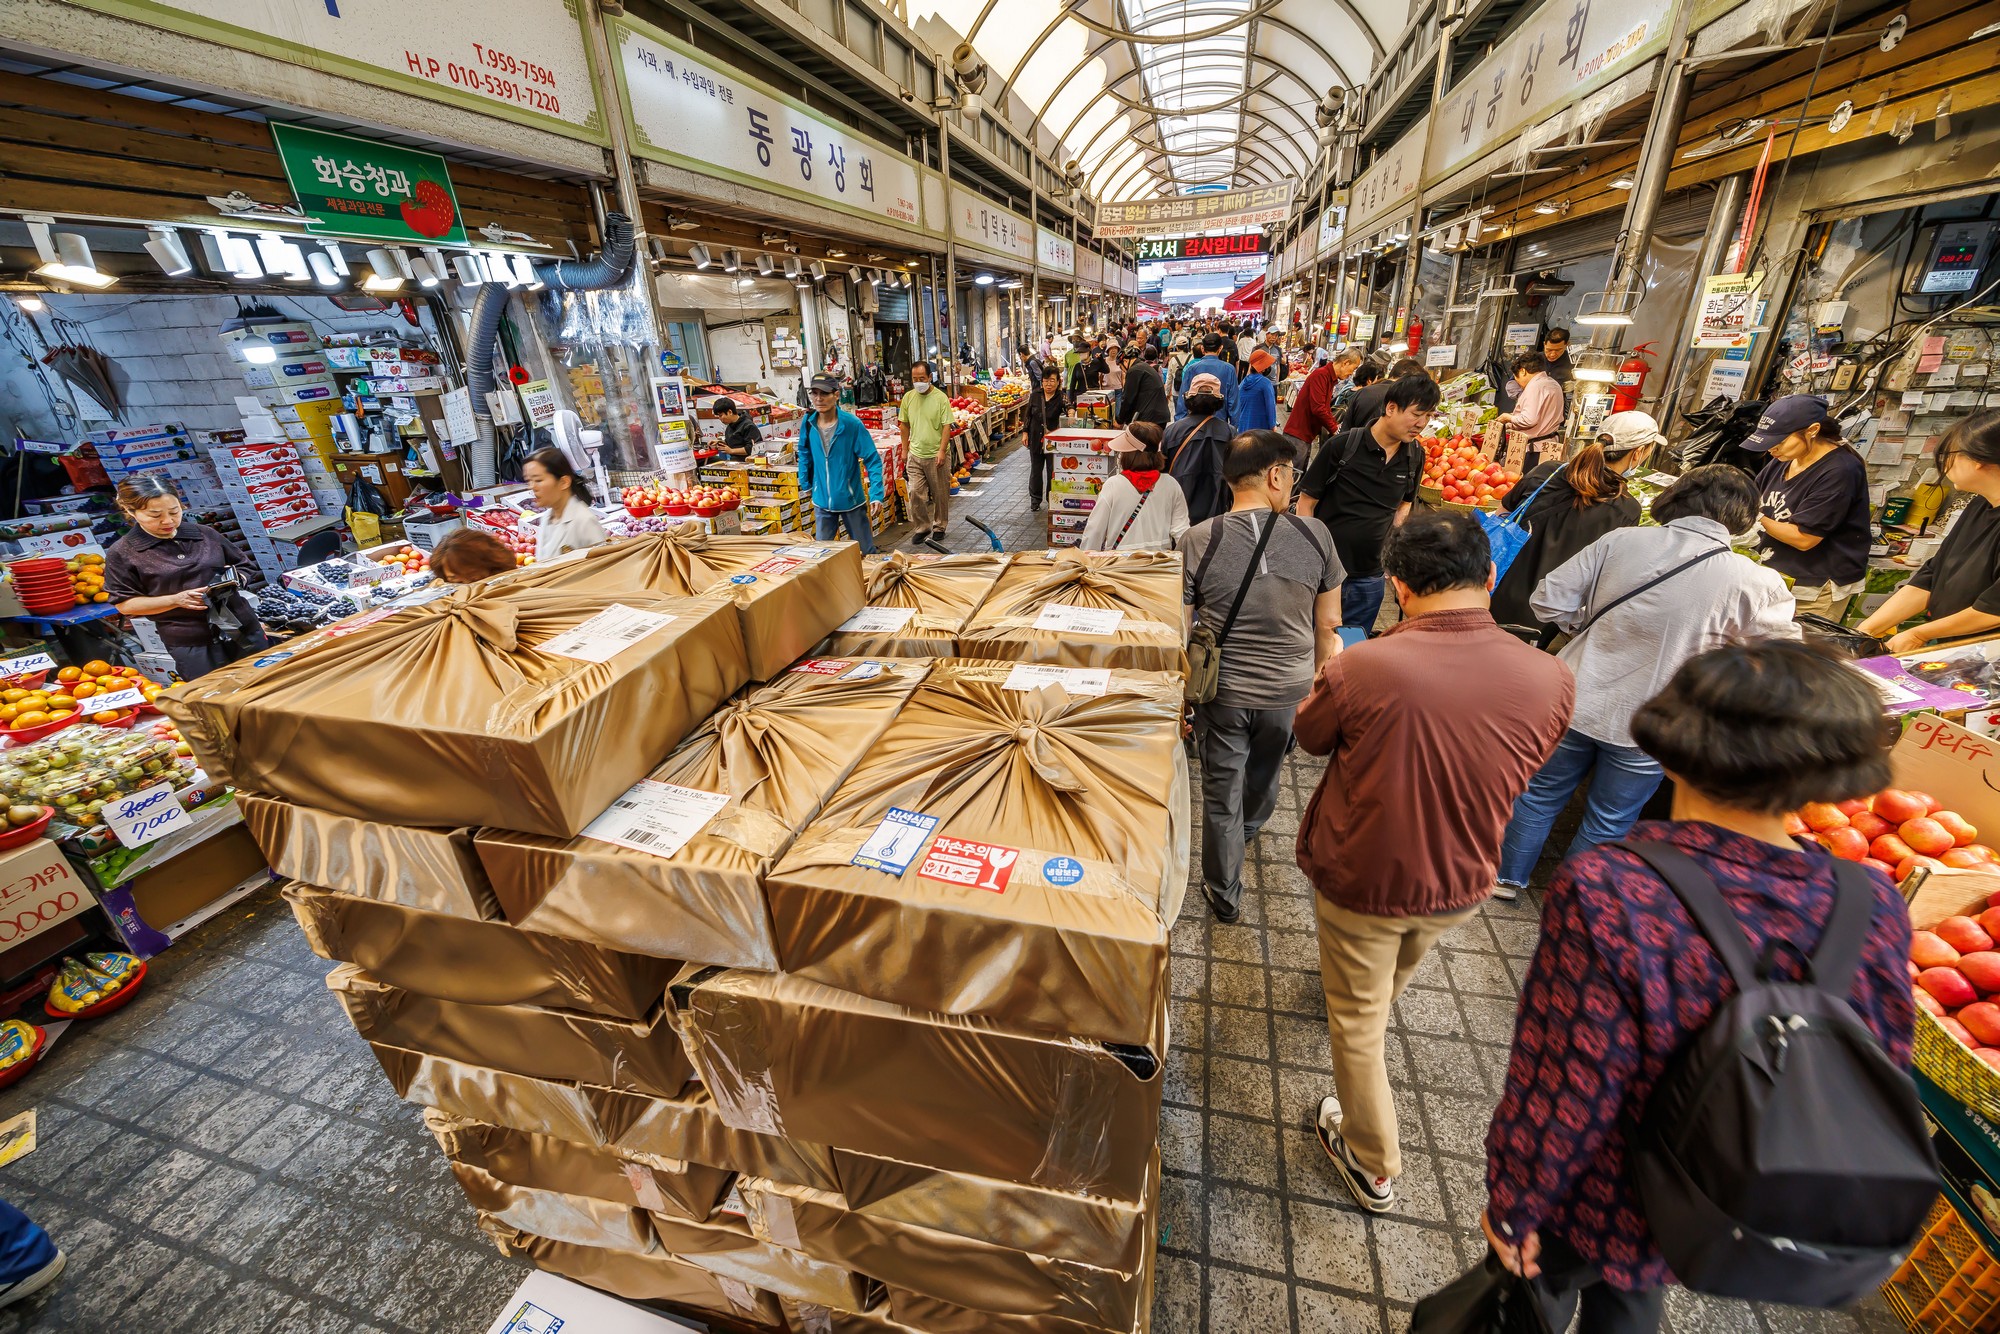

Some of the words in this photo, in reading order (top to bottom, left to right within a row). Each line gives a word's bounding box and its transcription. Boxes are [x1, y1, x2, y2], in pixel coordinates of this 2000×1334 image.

[405, 50, 441, 79] H.P
[447, 62, 560, 114] 010-5391-7220
[472, 42, 556, 89] T.959-7594
[636, 46, 662, 74] 사과,
[681, 67, 716, 97] 수입과일
[718, 84, 734, 106] 전문
[746, 106, 876, 203] 동광상회
[311, 155, 412, 198] 화승청과
[324, 197, 386, 216] 제철과일전문
[980, 209, 1018, 248] 대덕농산
[1185, 234, 1260, 256] 감사합니다
[527, 392, 553, 407] 환급행사
[531, 403, 556, 417] 참여점포
[1915, 722, 1994, 761] 아리수
[885, 809, 938, 830] 신선식품
[934, 837, 991, 860] 파손주의
[0, 863, 69, 911] 드키위
